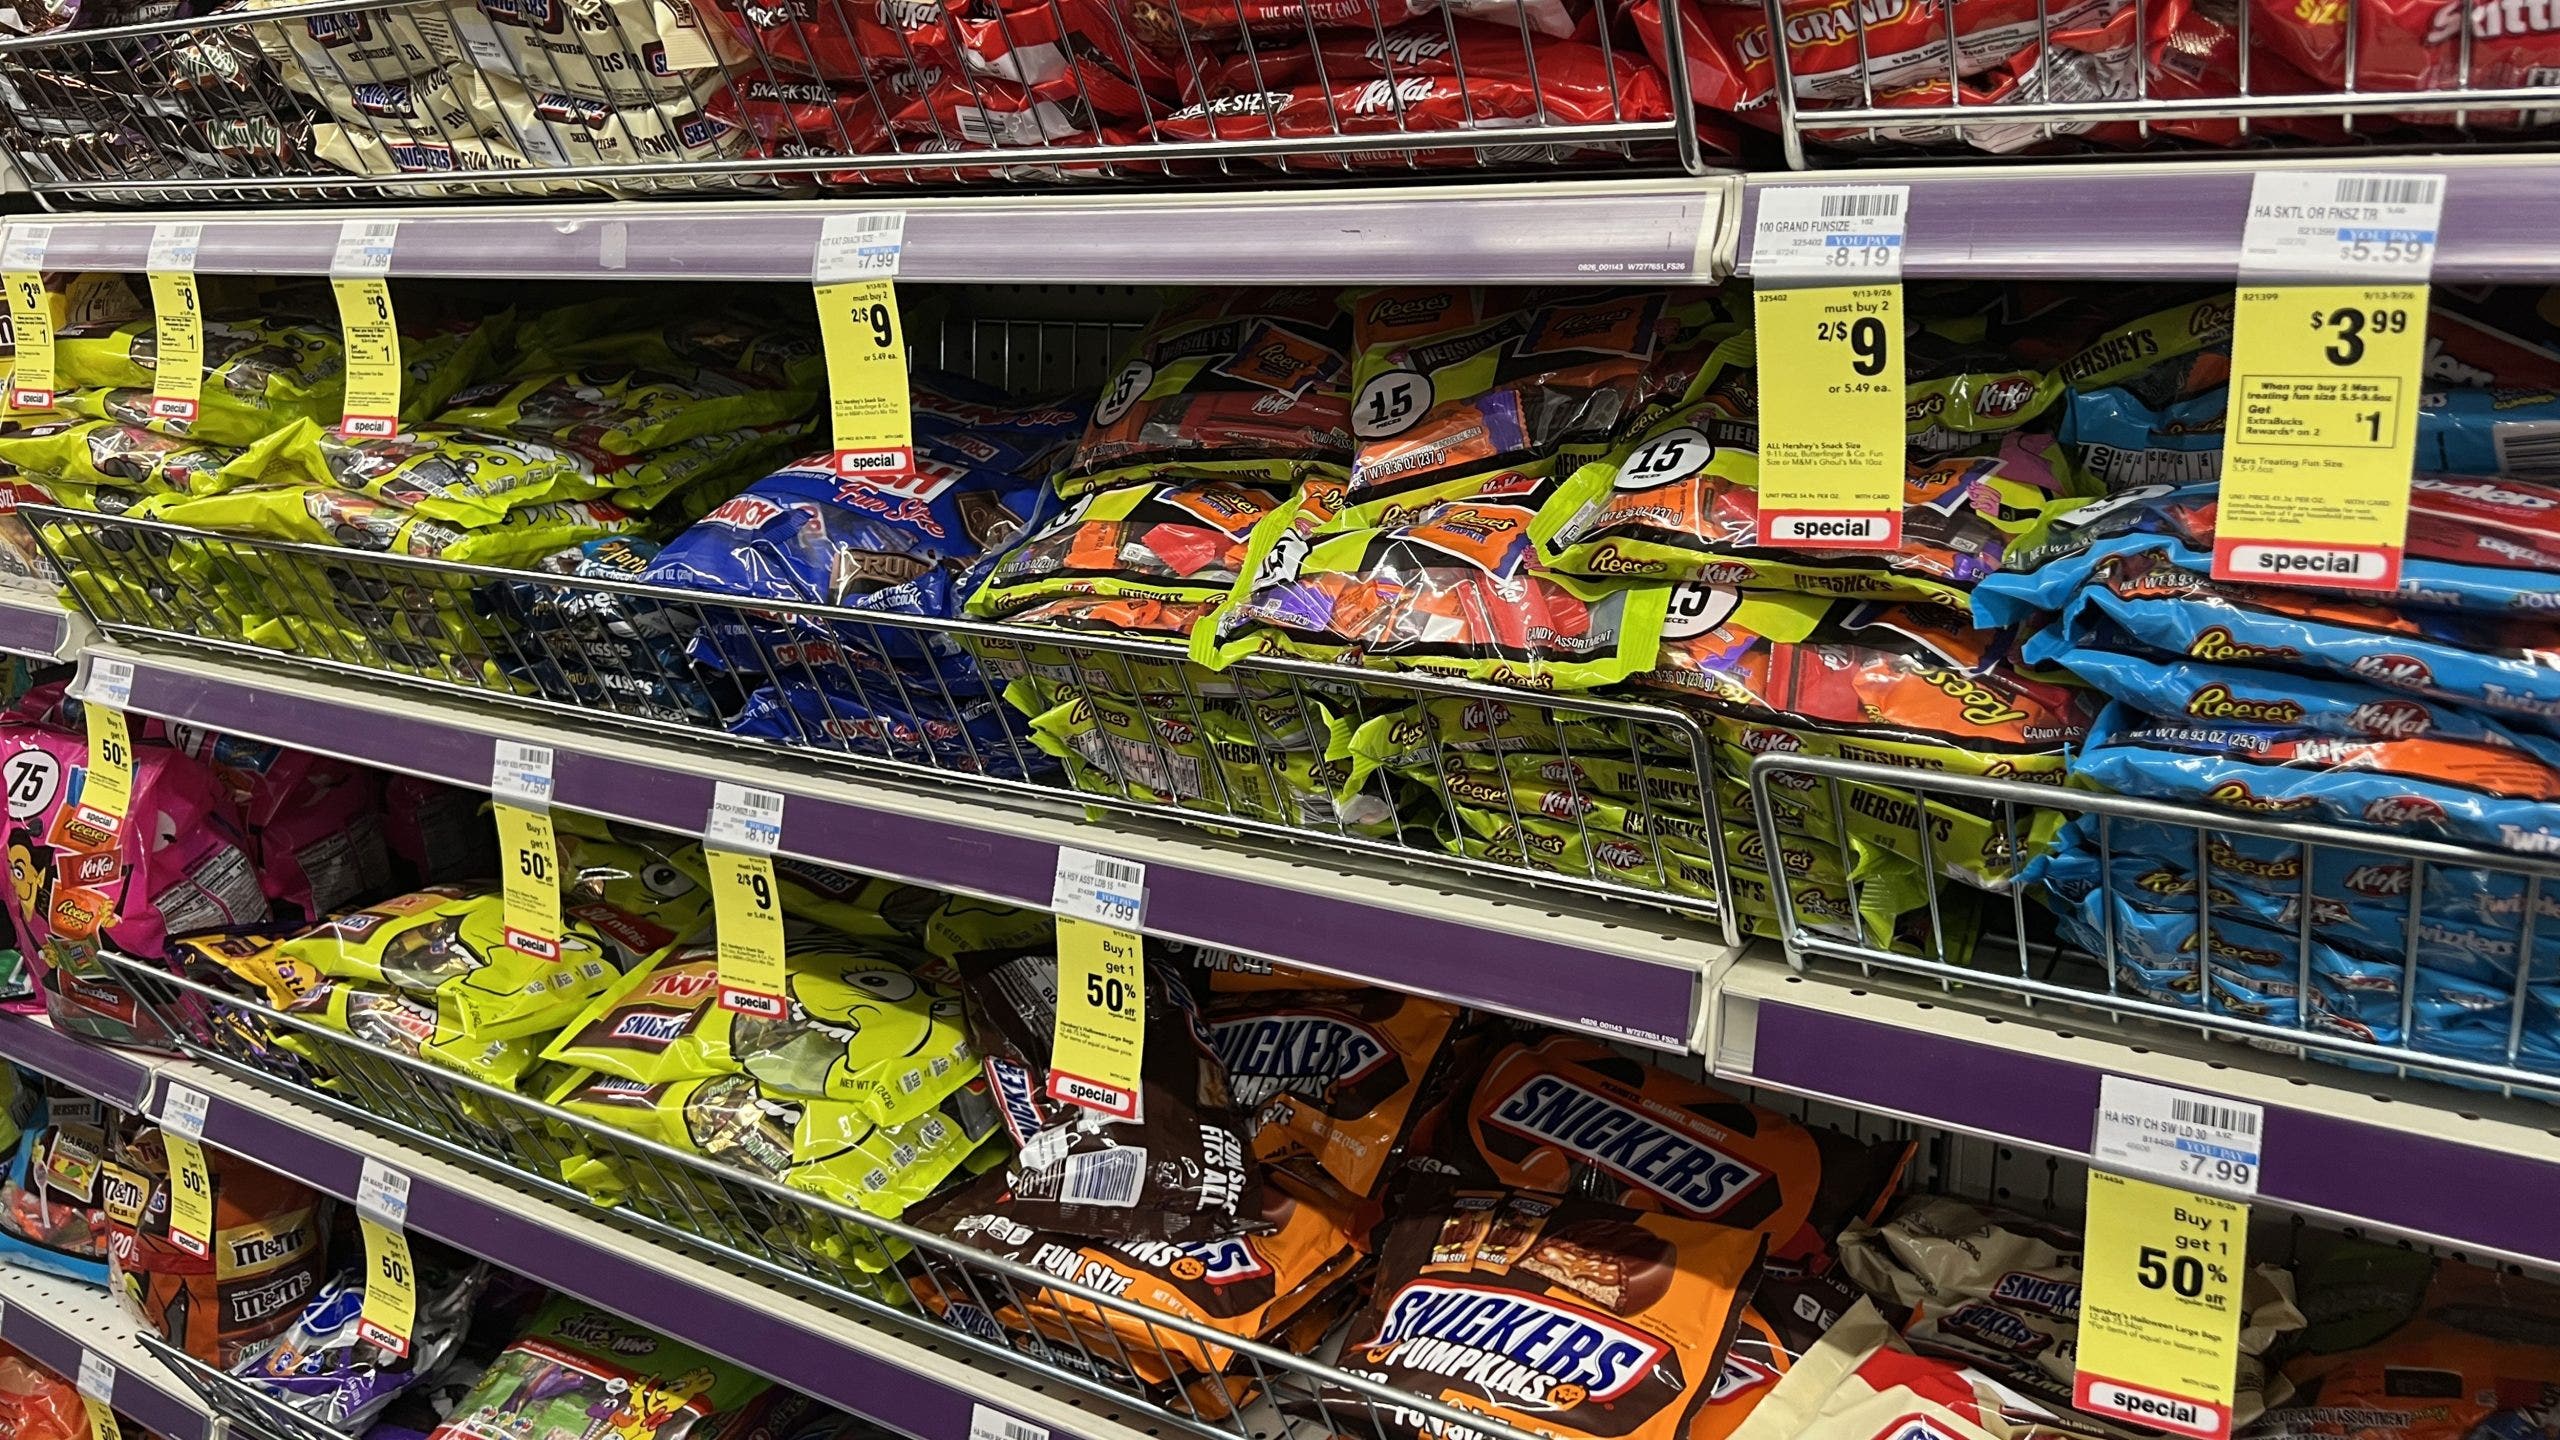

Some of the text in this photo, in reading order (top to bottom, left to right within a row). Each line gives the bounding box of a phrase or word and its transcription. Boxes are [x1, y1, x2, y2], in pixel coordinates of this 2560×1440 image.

[1787, 0, 1901, 42] GRAND
[750, 80, 798, 98] SNACK
[2254, 206, 2271, 218] HA
[2274, 206, 2303, 219] SKTL
[2327, 207, 2359, 220] FNSZ
[1760, 221, 1850, 232] 100 GRAND FUNSIZE
[1834, 236, 1859, 245] YOU
[1864, 236, 1890, 245] PAY
[858, 253, 894, 270] $7.99
[1826, 246, 1890, 267] $8.19
[852, 291, 888, 302] must buy 2
[1760, 290, 1892, 302] 325402 9/13-9/26
[1367, 293, 1453, 326] Reese's
[1825, 301, 1889, 313] must buy 2
[1420, 323, 1511, 366] HERSHEY'S
[864, 353, 886, 362] or 5.49
[1828, 383, 1891, 394] or 5.49 ea.
[2247, 392, 2288, 401] treating
[2294, 384, 2313, 392] you
[2317, 383, 2337, 392] buy
[2353, 384, 2378, 392] Mars
[23, 394, 44, 403] special
[162, 403, 187, 414] special
[1367, 383, 1414, 425] 15
[2248, 405, 2271, 413] Get
[354, 420, 384, 432] special
[2247, 417, 2303, 426] ExtraBucks
[854, 454, 895, 470] special
[1405, 455, 1420, 470] OZ
[1630, 438, 1691, 474] 15
[1801, 450, 1844, 458] Butterfinger
[2233, 457, 2256, 465] Mars
[2259, 457, 2298, 467] Treating
[833, 481, 946, 539] Fun Size
[1794, 519, 1870, 538] special
[1591, 547, 1668, 574] Reese's
[2260, 552, 2359, 573] special
[1699, 564, 1759, 584] KitKat
[1794, 573, 1895, 594] HERSHEY'S
[1525, 626, 1613, 649] CANDY ASSORTMENT
[2190, 682, 2300, 722] Reese's
[2350, 704, 2431, 737] KitKat
[1155, 720, 1194, 745] KitKat
[1740, 729, 1802, 753] KitKat
[2023, 726, 2060, 740] CANDY
[2155, 728, 2255, 750] WT 8.93 OZ (253
[8, 761, 45, 802] 75
[1984, 760, 2067, 788] Reese's
[86, 812, 114, 827] special
[526, 822, 541, 835] Buy
[531, 839, 544, 850] get
[745, 829, 775, 845] $8.19
[1596, 841, 1646, 868] KitKat
[79, 858, 115, 879] KitKat
[56, 902, 94, 923] Reese's
[1096, 900, 1134, 921] $7.99
[517, 936, 548, 954] special
[1103, 940, 1133, 958] Buy 1
[1106, 962, 1134, 976] get 1
[1194, 950, 1230, 975] FUN
[734, 994, 771, 1011] special
[1042, 985, 1057, 1004] 80
[1124, 1008, 1136, 1017] off
[1070, 1084, 1117, 1106] special
[2105, 1110, 2207, 1140] HA HSY CH SW LD 30
[61, 1132, 99, 1155] HARIBO
[1499, 1077, 1751, 1213] SNICKERS
[2187, 1142, 2244, 1161] YOU PAY
[1196, 1125, 1227, 1211] FITS ALL
[2180, 1153, 2250, 1185] $7.99
[2173, 1207, 2230, 1233] Buy 1
[2176, 1235, 2227, 1256] get 1
[1450, 1253, 1470, 1264] SIZE
[1035, 1243, 1134, 1296] FUN SIZE
[234, 1272, 312, 1322] m&m's
[2205, 1294, 2227, 1305] off
[370, 1327, 398, 1348] special
[1382, 1290, 1643, 1394] SNICKERS
[1387, 1338, 1555, 1399] PUMPKINS
[2113, 1391, 2197, 1423] special
